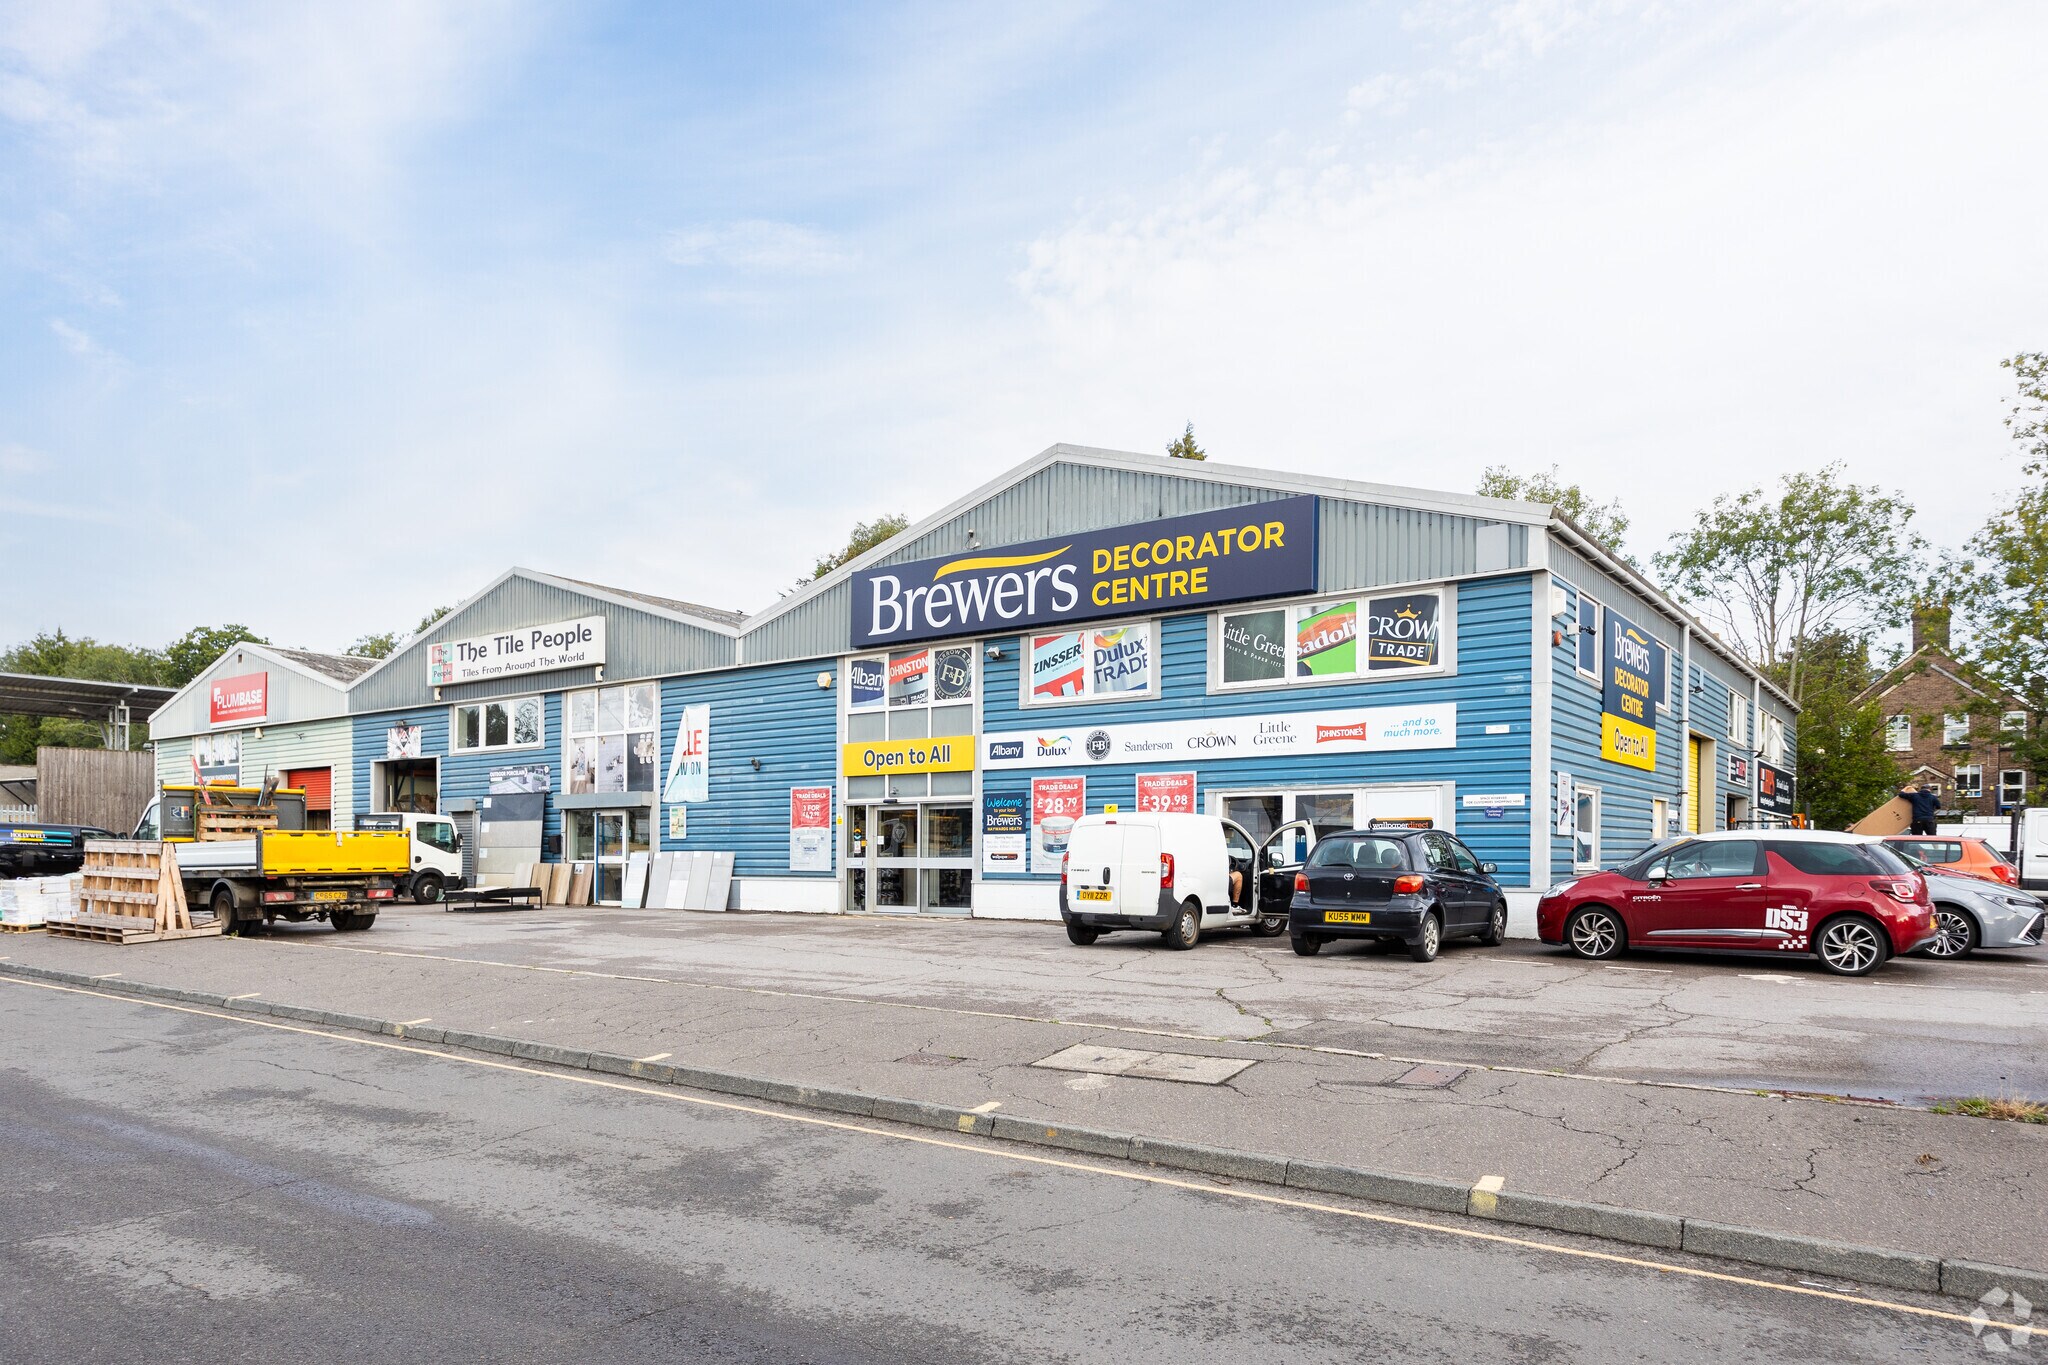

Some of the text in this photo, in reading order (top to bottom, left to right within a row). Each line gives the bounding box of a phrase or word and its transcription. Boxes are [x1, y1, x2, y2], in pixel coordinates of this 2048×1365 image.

[1092, 520, 1286, 575] DECORATOR
[1091, 566, 1209, 607] CENTRE
[867, 563, 1080, 637] Brewers
[457, 623, 592, 663] The Tile People
[1378, 642, 1425, 658] TRADE
[1614, 620, 1650, 675] Brewers
[1034, 643, 1081, 675] ZINSSER
[1094, 638, 1145, 667] Dulux
[462, 652, 585, 677] Tiles From Around The World
[906, 675, 920, 683] TRADE
[940, 663, 967, 686] F&B
[1614, 666, 1649, 698] DECORATOR
[217, 689, 262, 709] PLUMBASE
[910, 692, 926, 701] TRADE
[1621, 693, 1644, 719] CENTRE
[1259, 721, 1291, 734] Little
[1402, 717, 1422, 727] and
[1424, 718, 1436, 726] so
[1253, 734, 1297, 745] Greene
[1318, 726, 1364, 740] JOHNSTONE'S
[1383, 727, 1442, 738] much more.
[1124, 740, 1173, 752] Sanderson
[1187, 735, 1237, 749] CROWN
[1613, 726, 1649, 759] Open to All
[863, 744, 951, 771] Open to All
[990, 744, 1022, 757] Albany
[1037, 746, 1068, 757] Dulux
[690, 761, 701, 775] ON
[986, 797, 1023, 808] Welcome
[1037, 797, 1078, 814] £28.79
[1142, 794, 1188, 812] £39.98
[986, 814, 1023, 826] Brewers
[1095, 892, 1108, 900] ZZR
[1328, 912, 1349, 921] KU55
[1765, 907, 1809, 931] DS3
